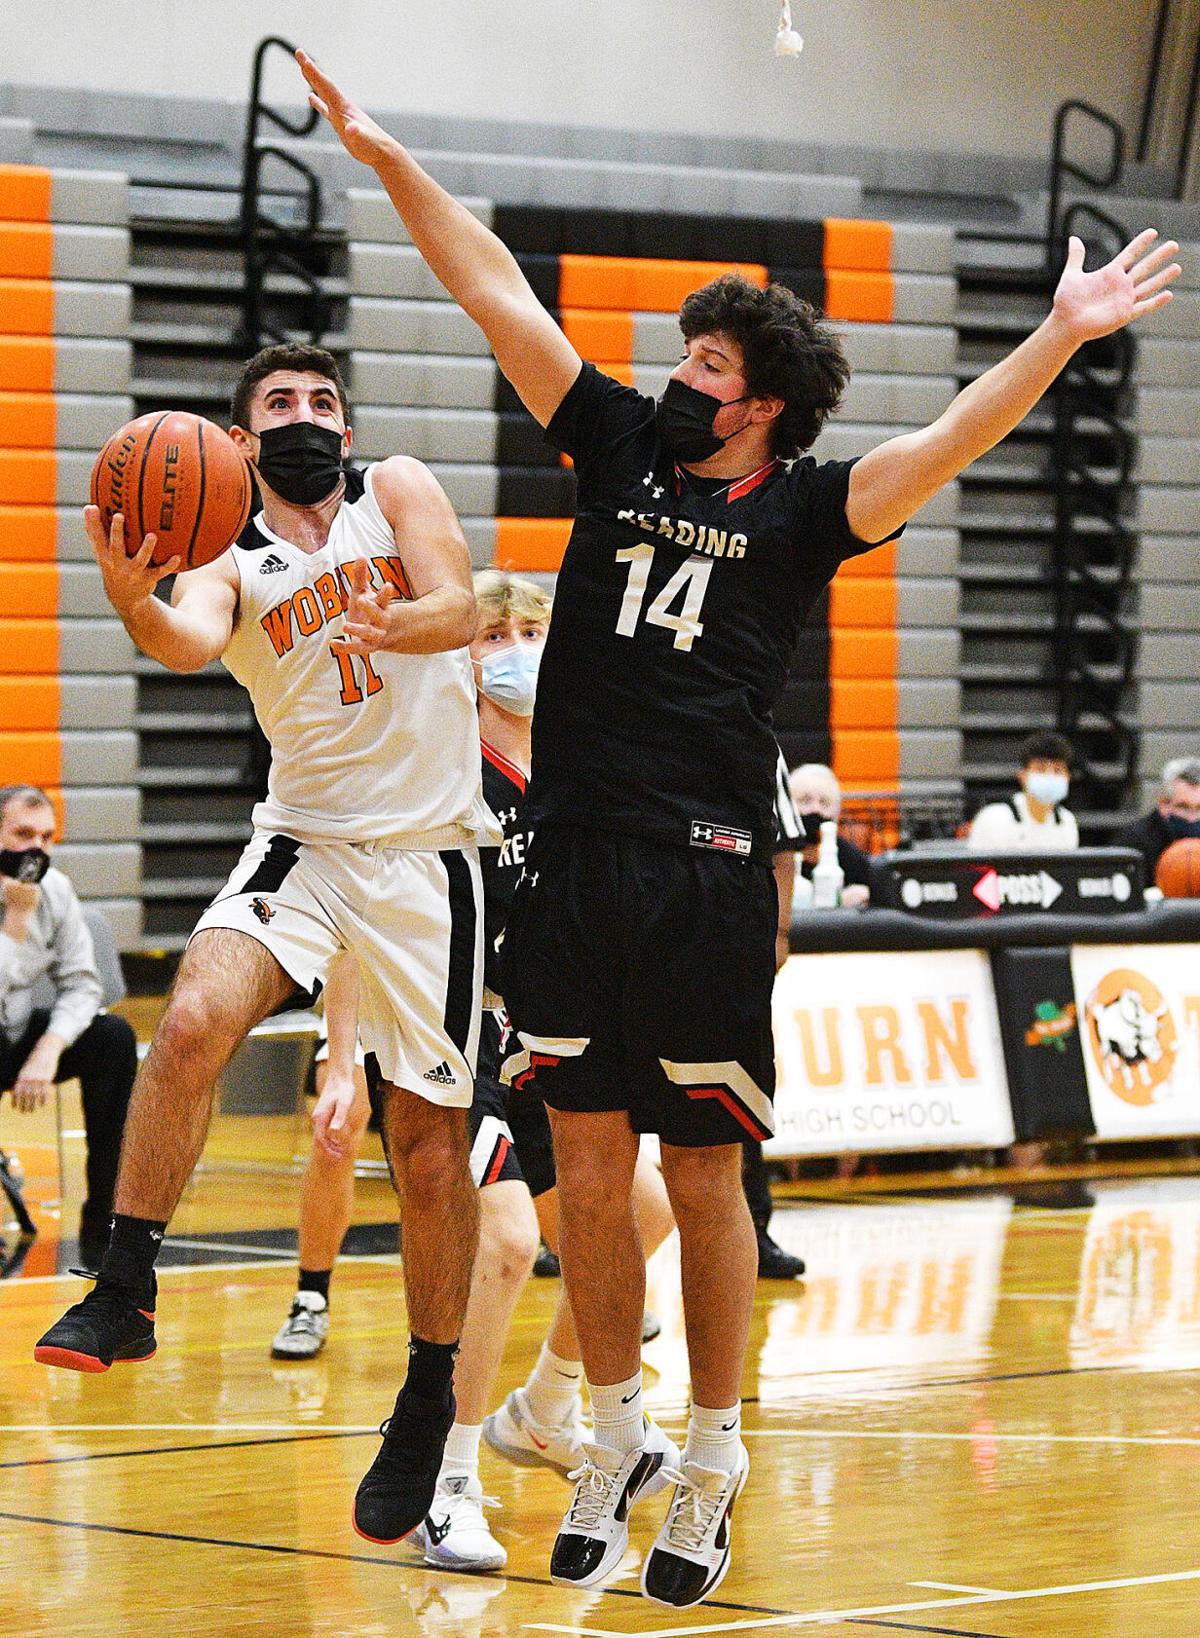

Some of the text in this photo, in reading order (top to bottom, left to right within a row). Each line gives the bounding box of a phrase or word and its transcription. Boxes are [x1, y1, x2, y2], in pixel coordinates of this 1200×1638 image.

[159, 444, 179, 531] ELITE
[259, 562, 290, 575] adidas
[615, 542, 714, 652] 14
[330, 635, 384, 705] 11
[498, 831, 534, 868] RE
[775, 998, 979, 1089] URN
[423, 1073, 456, 1084] adidas
[781, 1101, 962, 1133] HIGH SCHOOL
